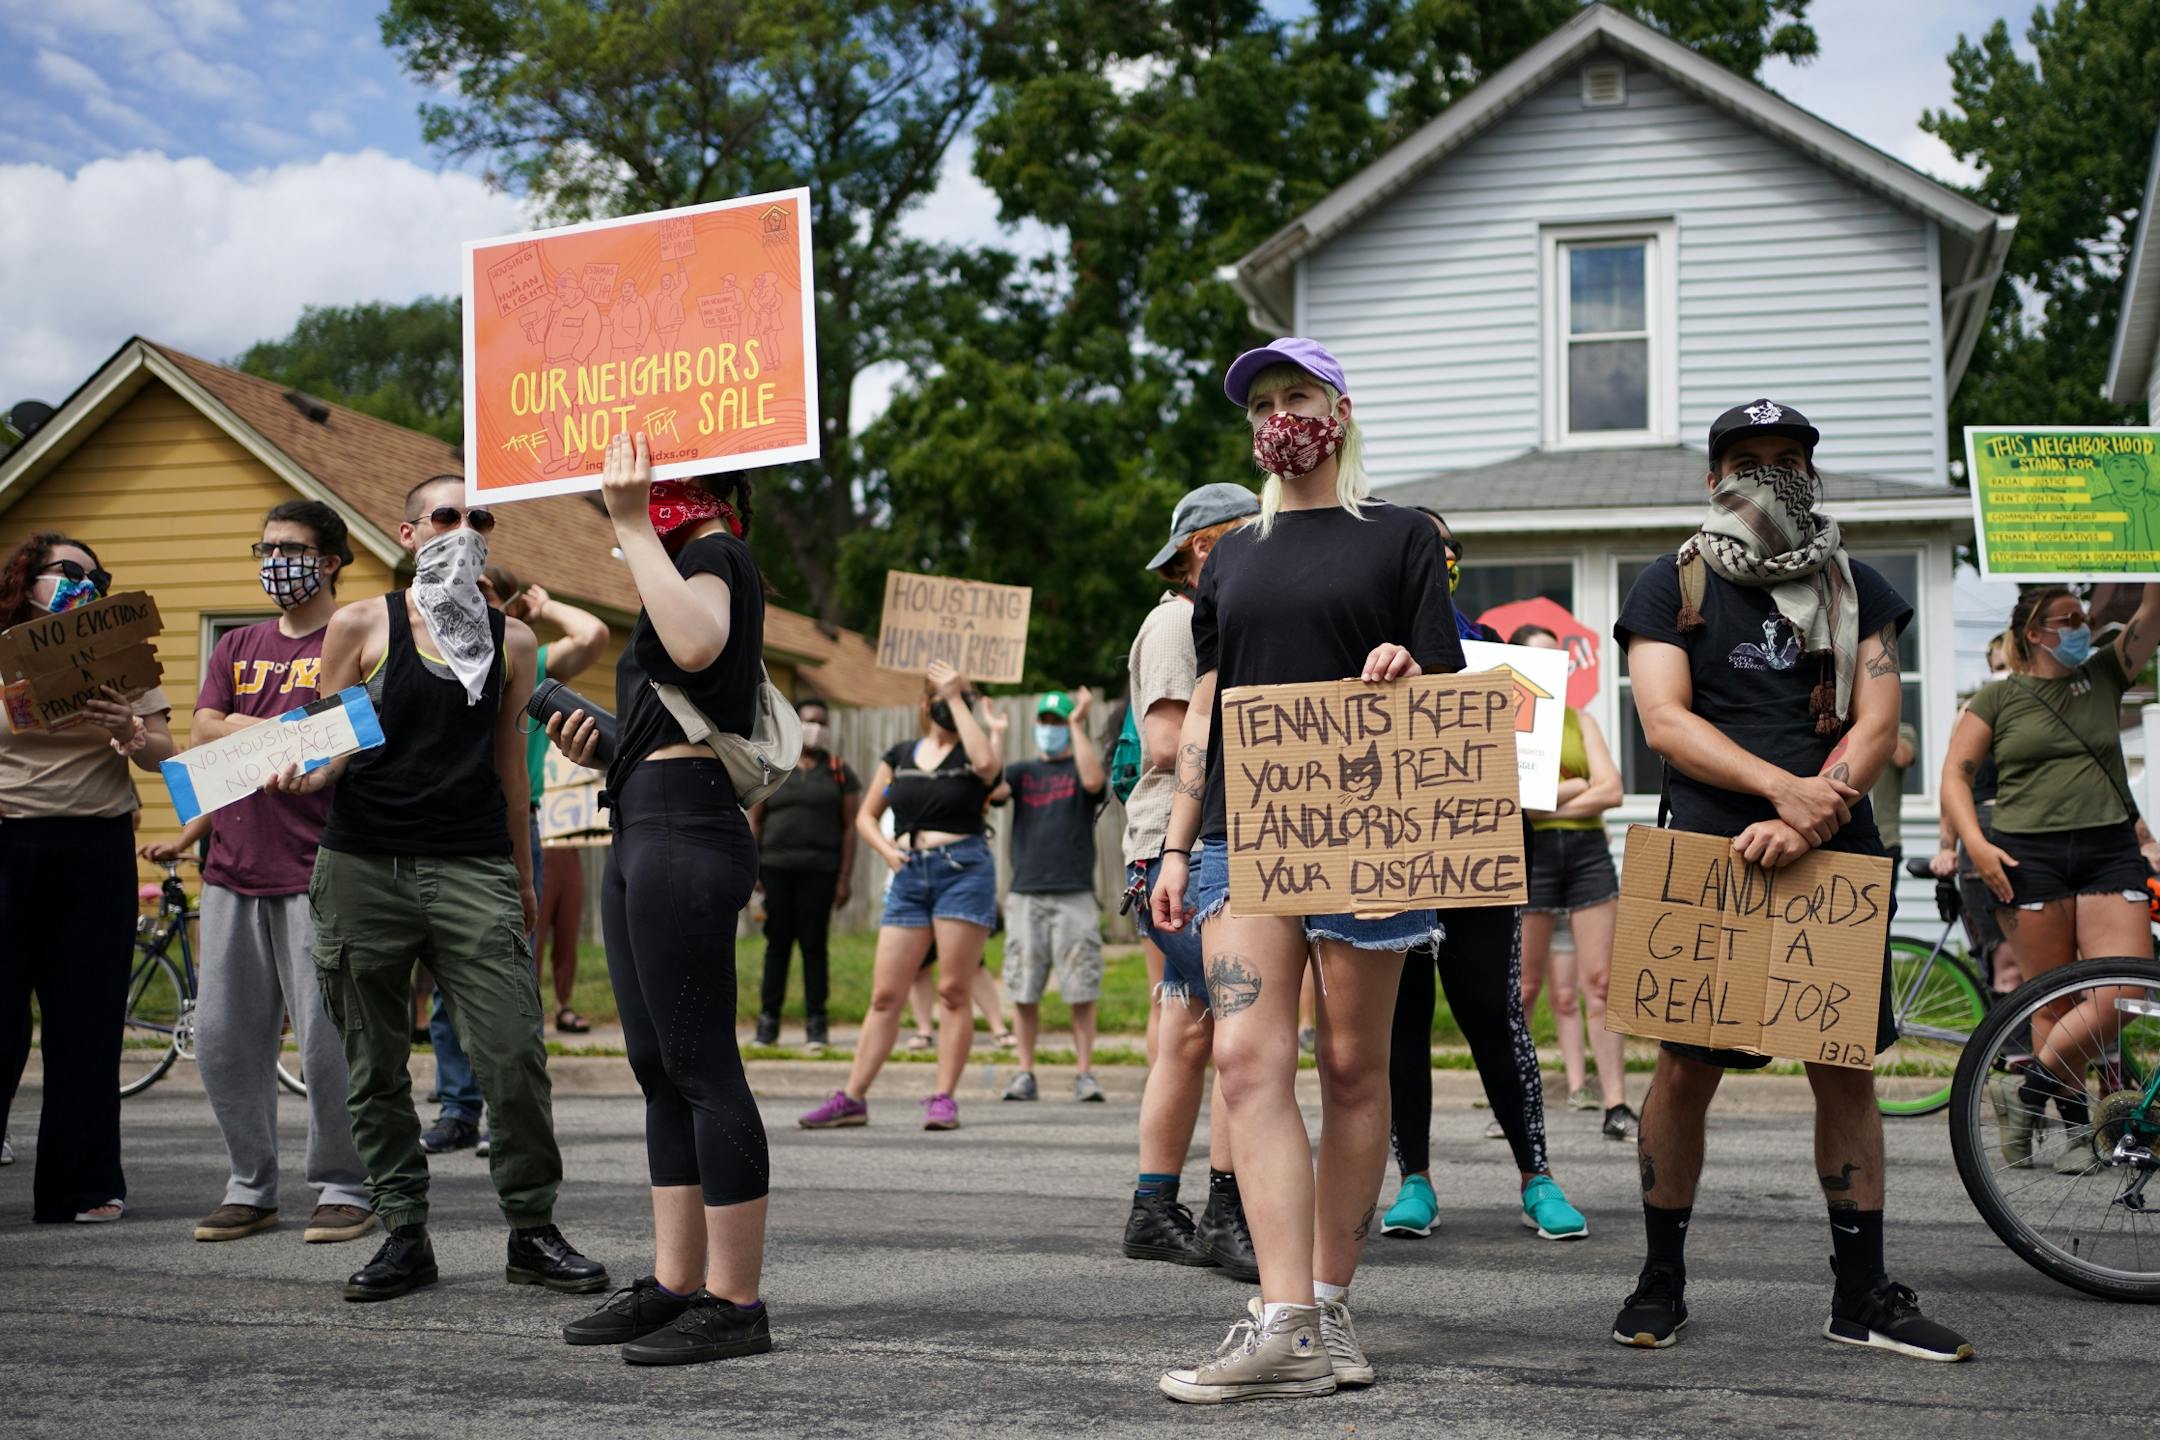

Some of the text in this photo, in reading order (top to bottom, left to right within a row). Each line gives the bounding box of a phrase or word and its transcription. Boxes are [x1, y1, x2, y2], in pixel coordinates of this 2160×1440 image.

[490, 252, 533, 279] HOUSING
[498, 275, 539, 304] HUMAN
[502, 284, 545, 312] RIGHT
[511, 339, 760, 416] OUR NEIGHBORS
[501, 382, 776, 463] ARE NOT FOR SALE
[1984, 435, 2156, 459] THIS NEIGHBORHOOD
[2019, 457, 2097, 472] STANDS FOR
[1991, 478, 2067, 487] RACIAL JUSTICE
[1995, 494, 2065, 502] RENT CONTROL
[1991, 513, 2097, 521] COMMUNITY OWNERSHIP
[1992, 533, 2031, 541] TENANT
[1993, 553, 2037, 561] STOPPING
[2093, 552, 2156, 560] DISPLACEMENT
[892, 576, 1023, 620] HOUSING
[28, 603, 149, 651] NO EVICTIONS
[939, 616, 976, 630] IS A
[71, 647, 97, 668] IN
[881, 623, 1025, 678] HUMAN RIGHT
[81, 669, 95, 683] A
[233, 660, 275, 696] U
[1224, 687, 1509, 748] TENANTS KEEP
[189, 720, 313, 777] NO HOUSING
[224, 723, 343, 793] NO PEACE
[1241, 739, 1498, 808] YOUR RENT
[1233, 796, 1517, 852] LANDLORDS KEEP
[1256, 850, 1524, 902] YOUR DISTANCE
[1661, 837, 1880, 927] LANDLORDS
[1648, 911, 1814, 967] GET A
[1635, 968, 1851, 1033] REAL JOB
[1818, 1041, 1872, 1067] 1312
